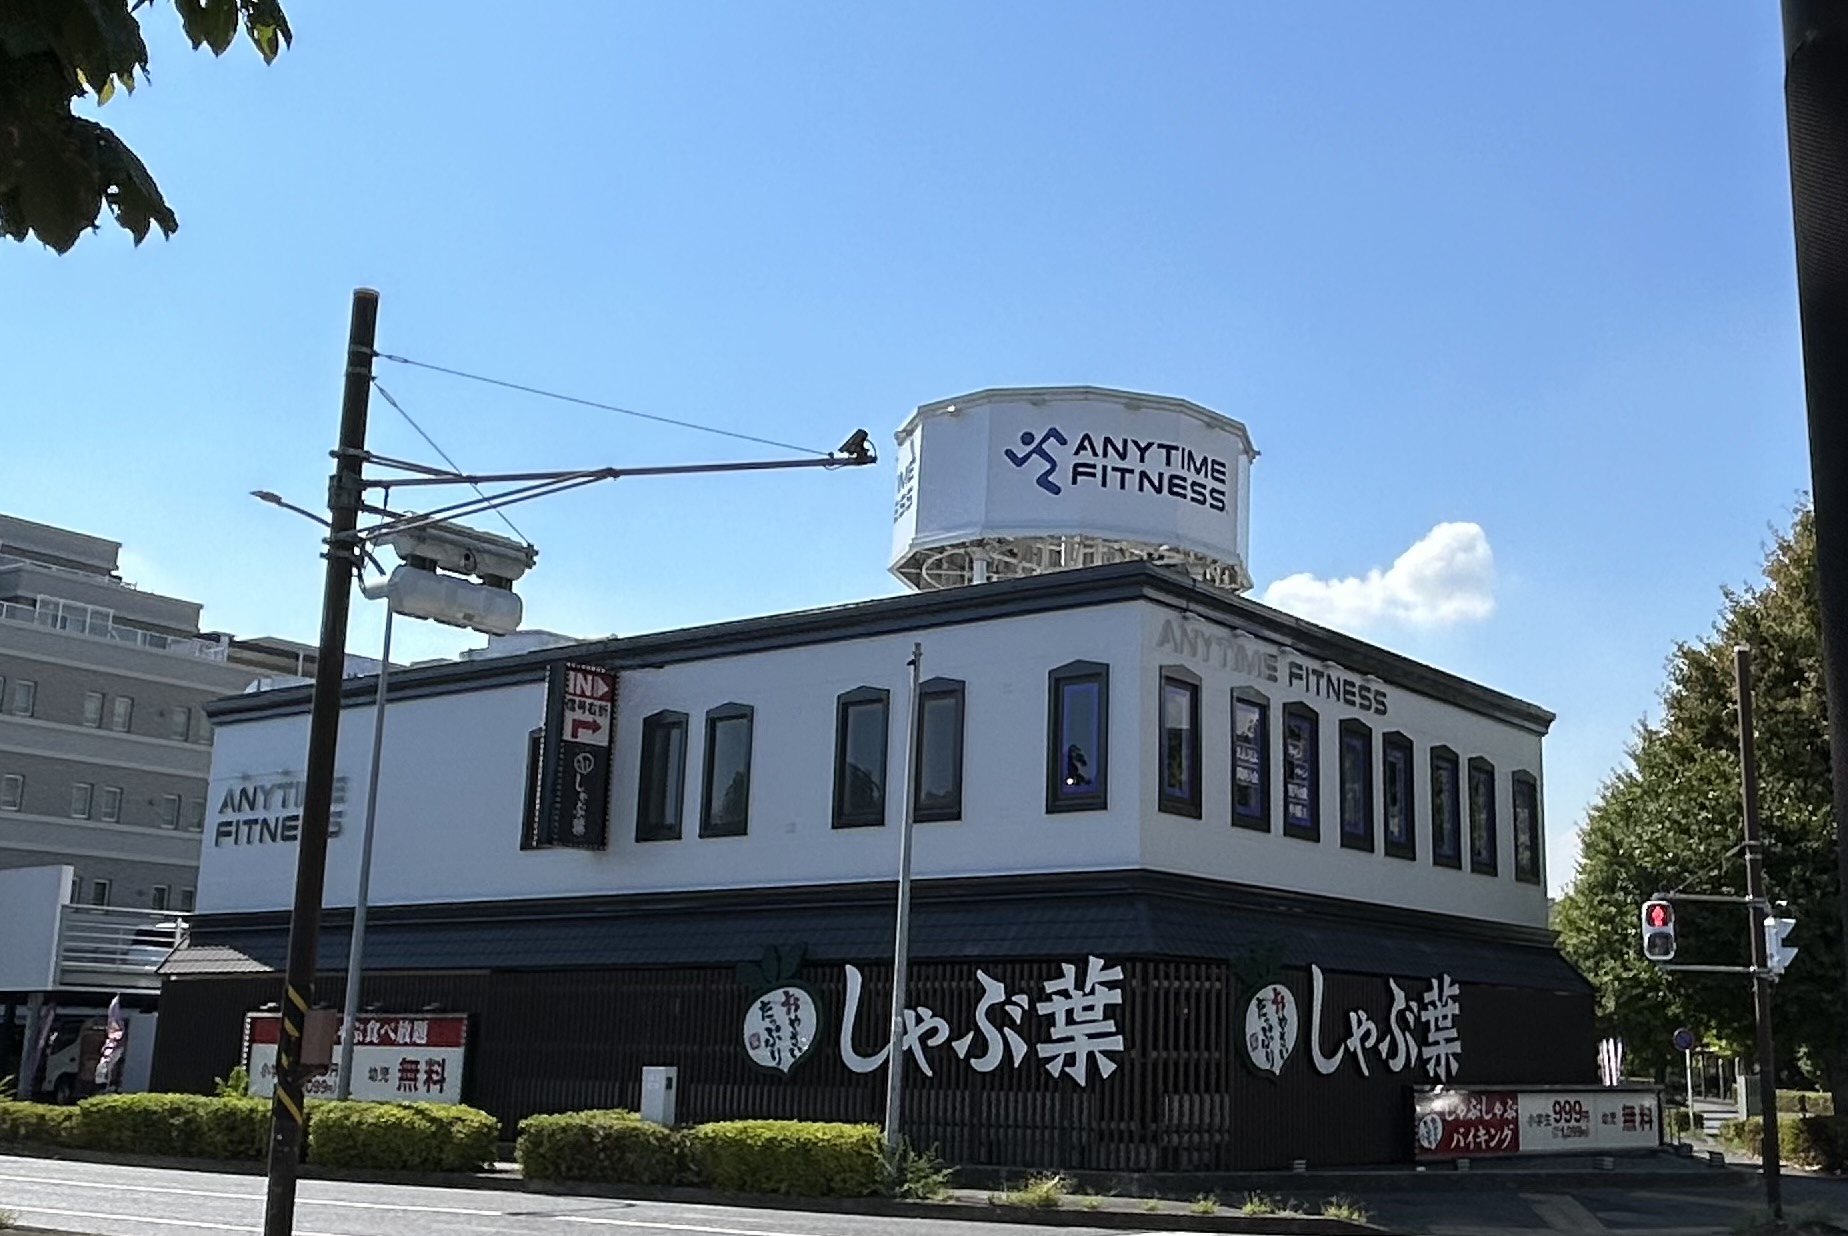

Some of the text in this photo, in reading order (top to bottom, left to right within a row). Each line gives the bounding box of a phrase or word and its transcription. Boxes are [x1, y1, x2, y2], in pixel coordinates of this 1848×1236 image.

[1073, 432, 1227, 485] ANYTIME
[1071, 462, 1227, 512] FITNESS
[568, 670, 593, 697] IN
[1156, 618, 1388, 716] ANYTIME FITNESS
[218, 777, 349, 814] ANYTIE
[215, 810, 343, 848] FITNES
[839, 954, 1125, 1087] しゃぶ葉
[1311, 963, 1462, 1082] しゃぶ葉
[396, 1056, 447, 1094] 無料
[1444, 1095, 1518, 1121] しゃぶしゃぶ
[1622, 1103, 1654, 1132] 無料
[1450, 1124, 1515, 1150] バイキング
